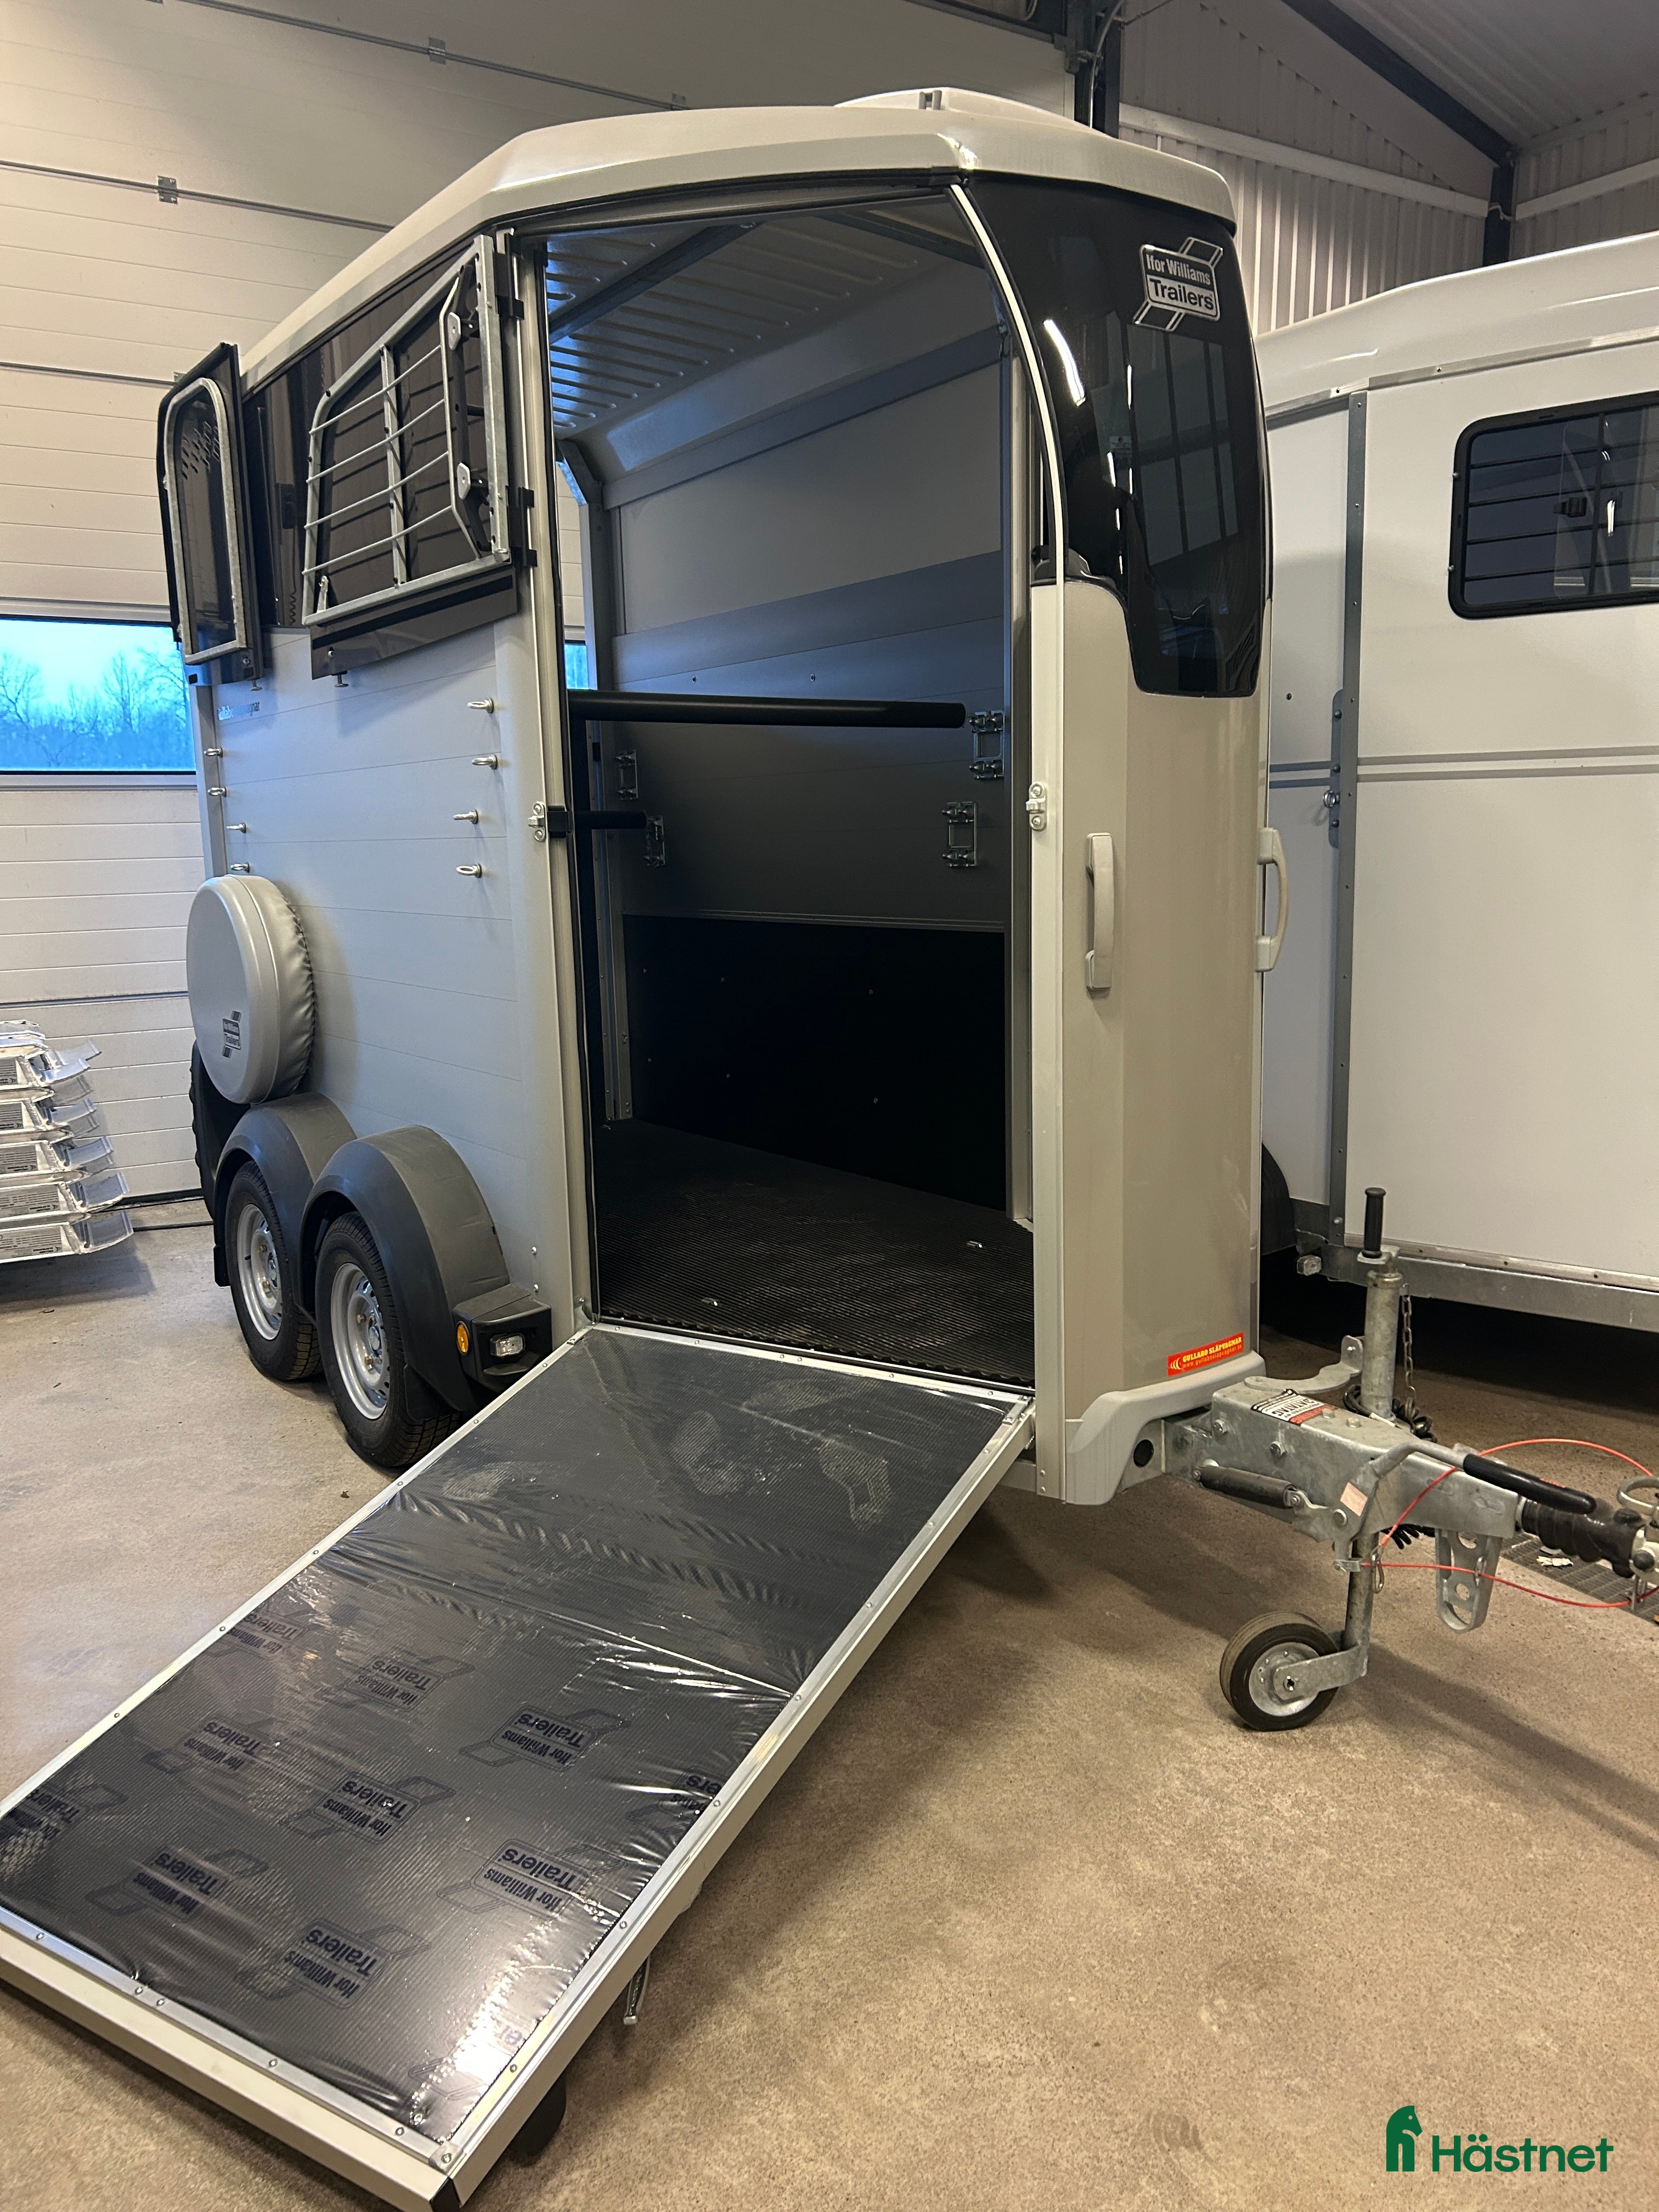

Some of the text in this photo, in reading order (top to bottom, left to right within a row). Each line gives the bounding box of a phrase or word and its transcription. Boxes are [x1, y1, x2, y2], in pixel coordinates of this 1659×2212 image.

[1146, 254, 1211, 285] Ifor Williams
[1150, 278, 1214, 311] Trailers
[1182, 1349, 1209, 1363] GULLABO
[1271, 1398, 1314, 1416] DATATAG
[355, 1675, 399, 1699] Williams
[371, 1660, 432, 1691] Trailers
[204, 1722, 262, 1757] Trailers
[501, 1730, 573, 1764] Ifor Williams
[517, 1713, 585, 1748] Trailers
[184, 1737, 228, 1764] Williams
[323, 1798, 371, 1828] Williams
[342, 1781, 407, 1819] Trailers
[155, 1853, 218, 1896] Trailers
[501, 1848, 577, 1891] Trailers
[133, 1872, 180, 1904] Williams
[483, 1868, 563, 1912] Ifor Williams
[306, 1929, 377, 1977] Trailers
[284, 1950, 360, 1999] Ifor Williams
